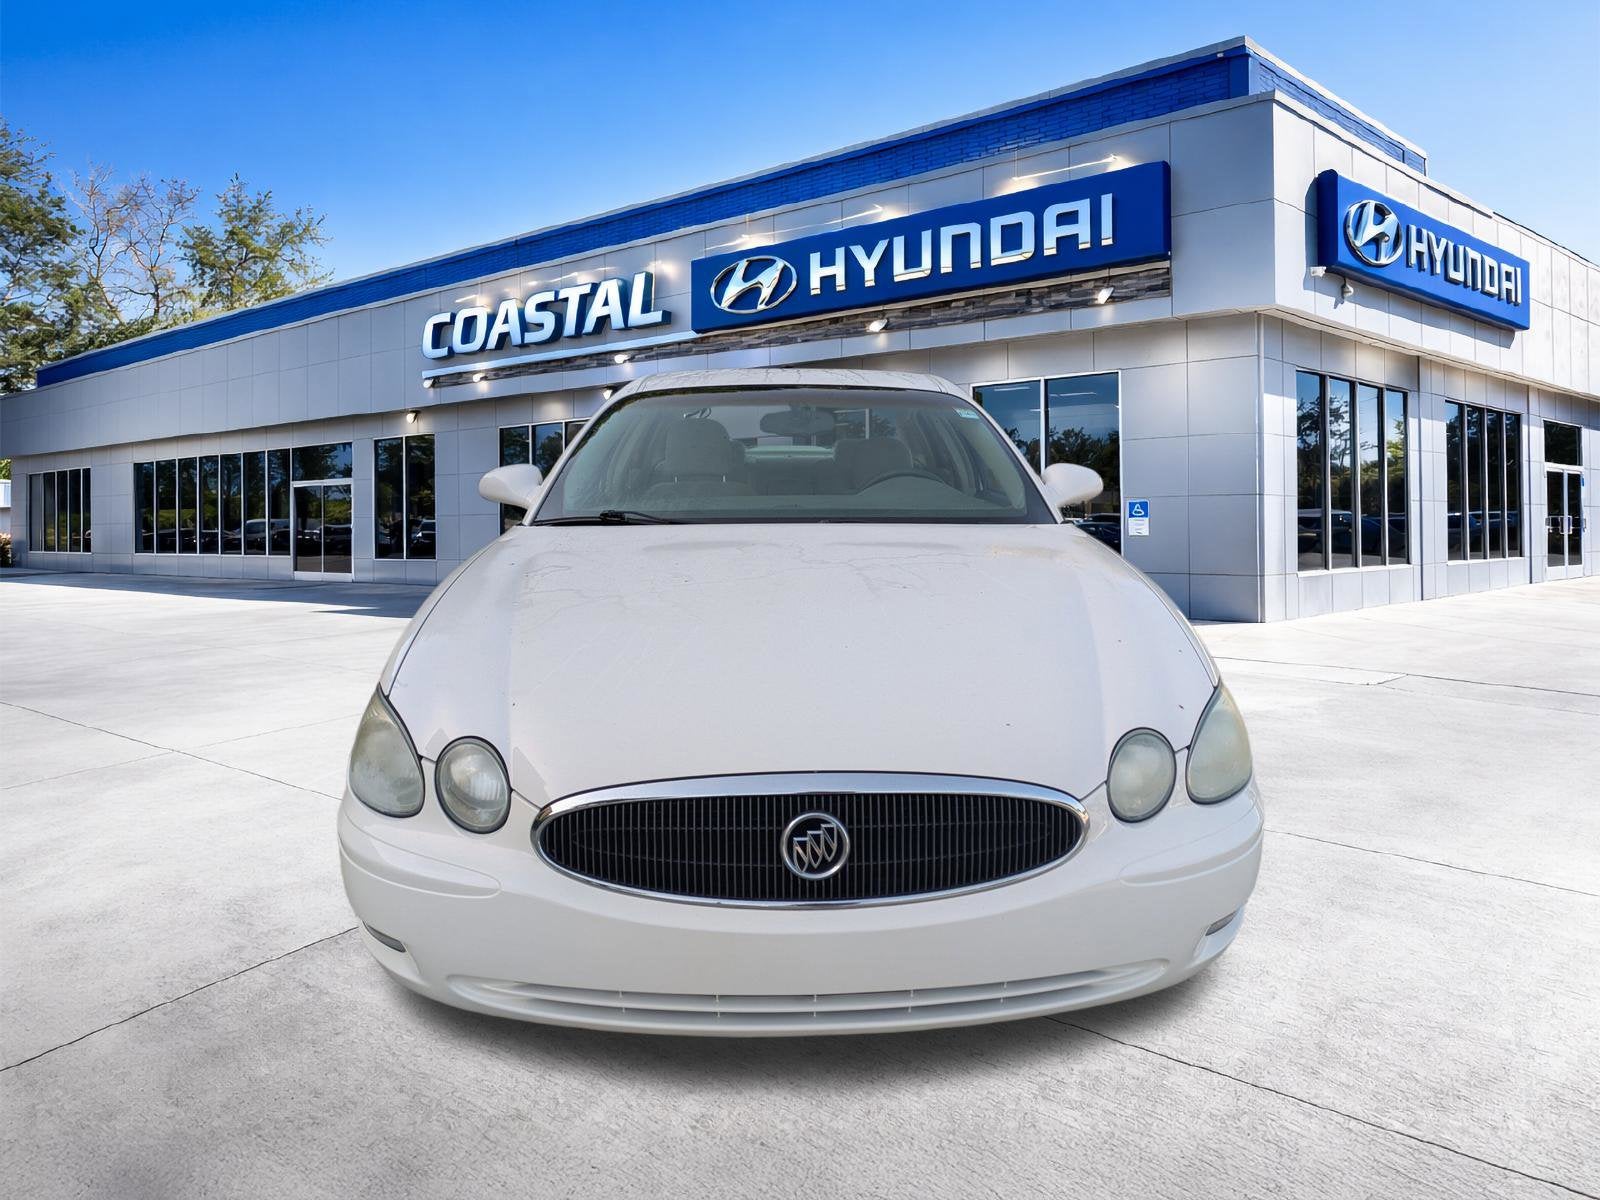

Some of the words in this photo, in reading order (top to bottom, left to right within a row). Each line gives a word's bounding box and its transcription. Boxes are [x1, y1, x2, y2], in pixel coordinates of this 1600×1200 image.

[810, 193, 1113, 295] HYUNDAI
[1406, 224, 1521, 306] HYUNDAI
[422, 271, 669, 359] COASTAL
